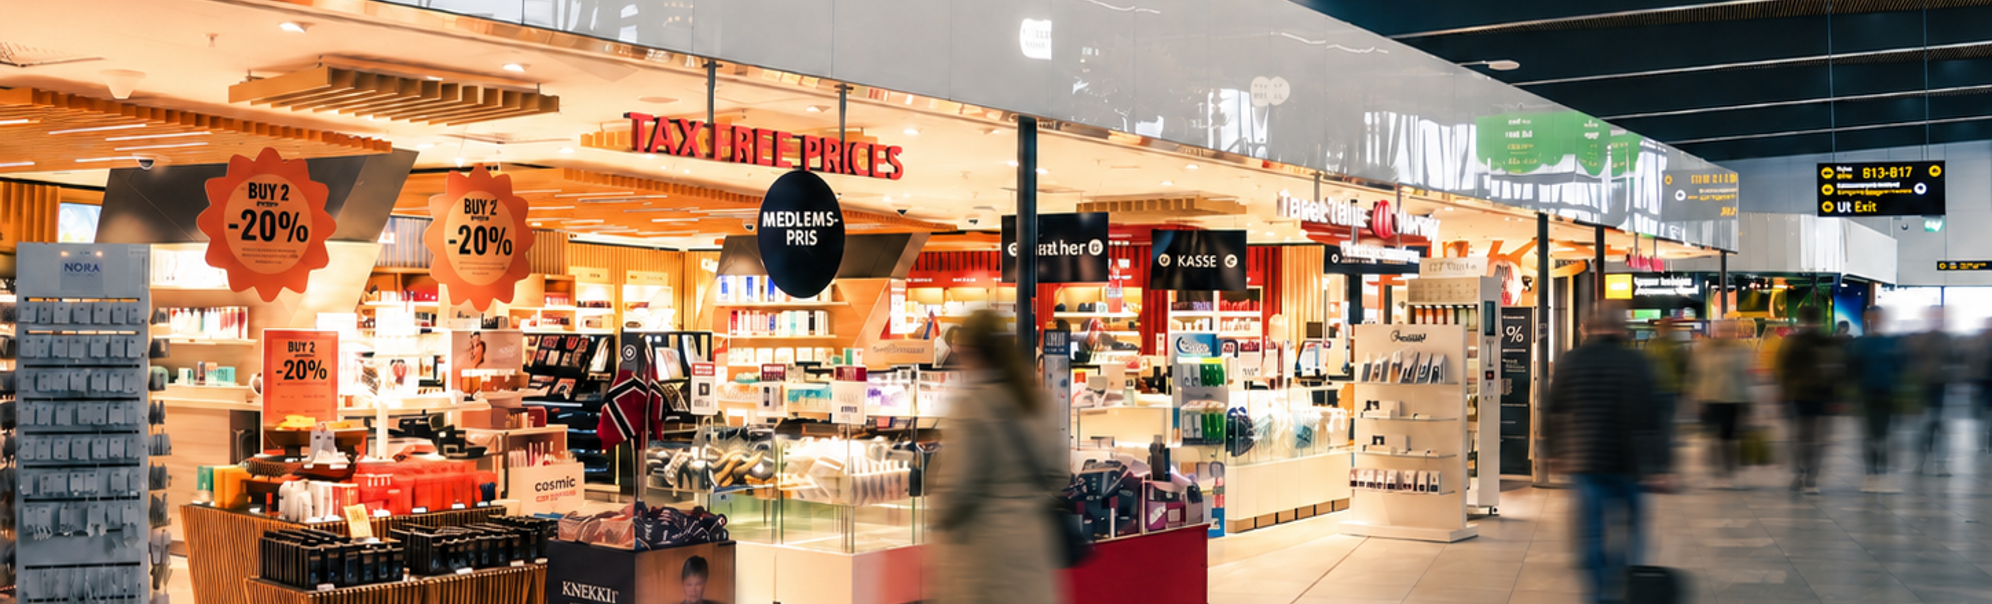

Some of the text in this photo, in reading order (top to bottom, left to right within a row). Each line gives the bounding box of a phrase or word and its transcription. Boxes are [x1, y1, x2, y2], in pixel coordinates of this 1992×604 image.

[626, 112, 904, 180] TAX FREE PRICES
[248, 182, 290, 202] BUY 2
[464, 197, 498, 216] BUY 2
[1837, 201, 1877, 213] Ut Exit
[228, 209, 309, 243] -20%
[762, 211, 839, 228] MEDLEMS-
[448, 224, 513, 256] -20%
[786, 229, 818, 246] PRIS
[64, 262, 100, 273] NORA
[1177, 254, 1217, 268] KASSE
[287, 341, 316, 353] BUY 2
[276, 359, 327, 380] -20%
[534, 475, 576, 492] cosmic
